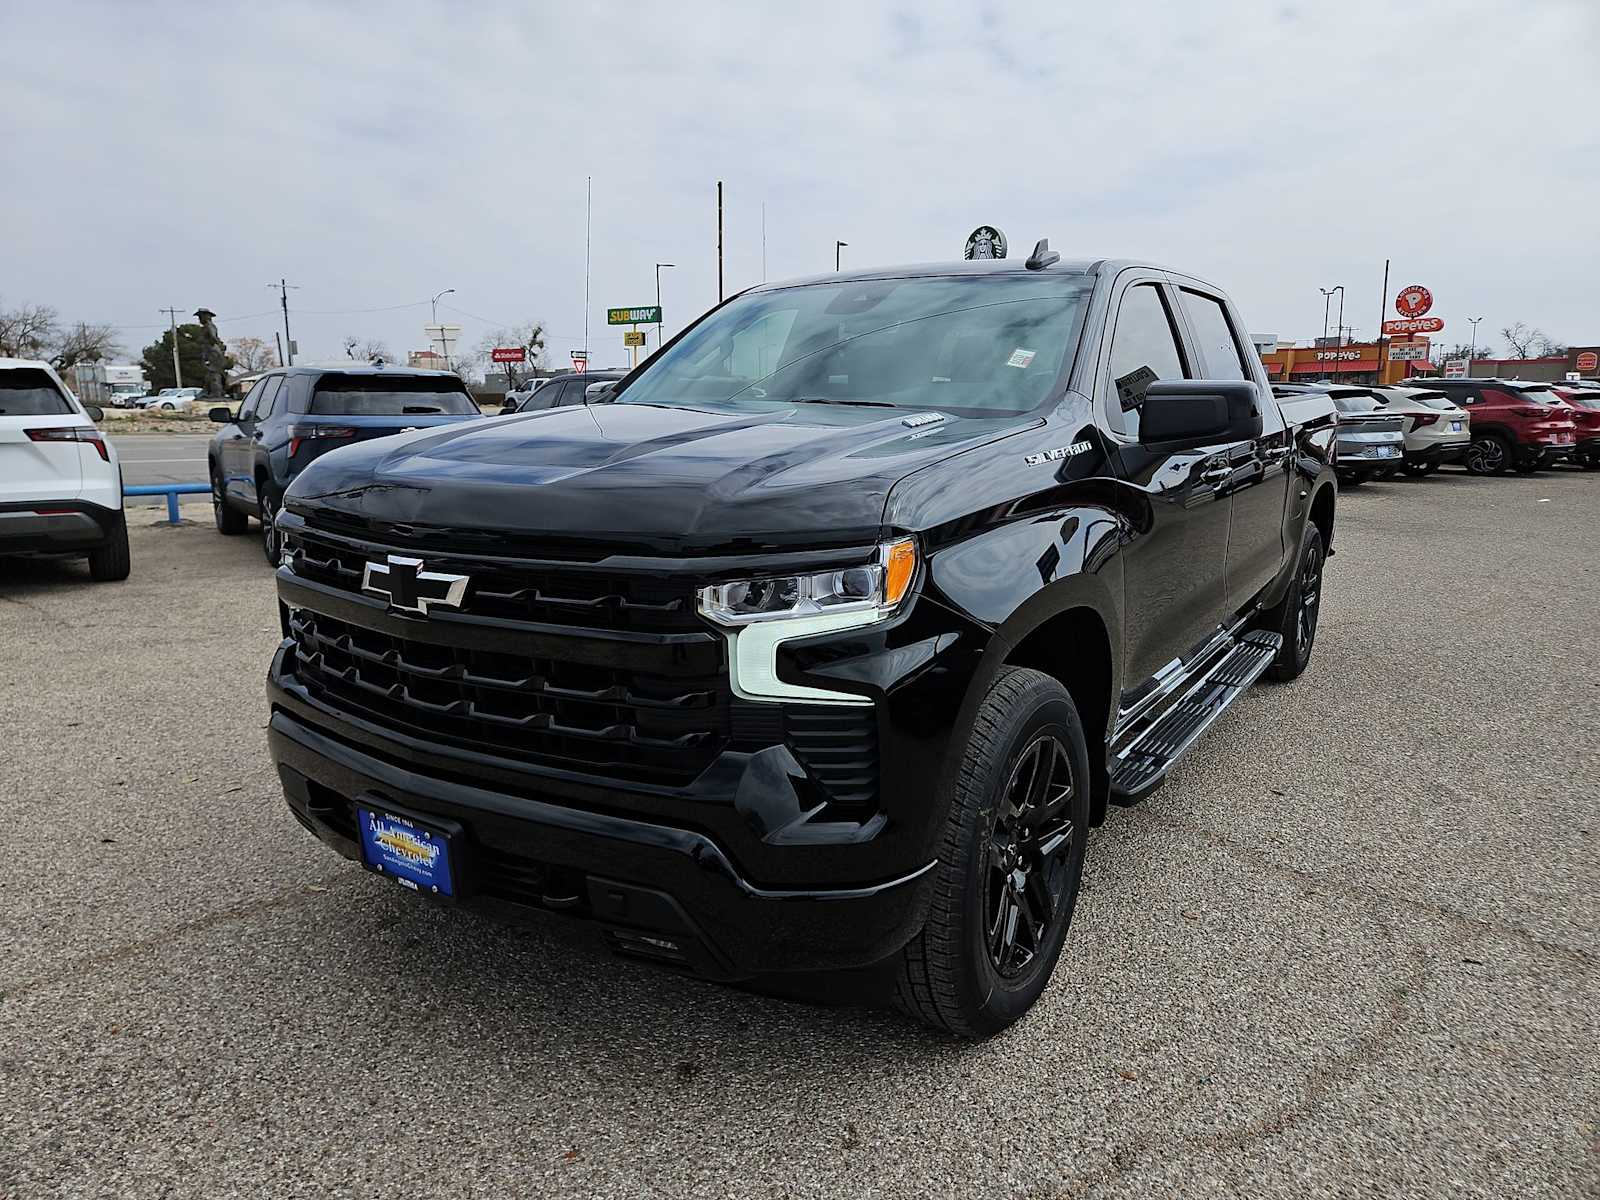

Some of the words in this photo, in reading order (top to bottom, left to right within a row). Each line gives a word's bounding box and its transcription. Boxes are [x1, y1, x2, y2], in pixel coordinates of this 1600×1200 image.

[610, 309, 654, 322] SUBWAY
[369, 819, 385, 832] All
[389, 825, 440, 856] American
[379, 838, 434, 869] Chevrolet
